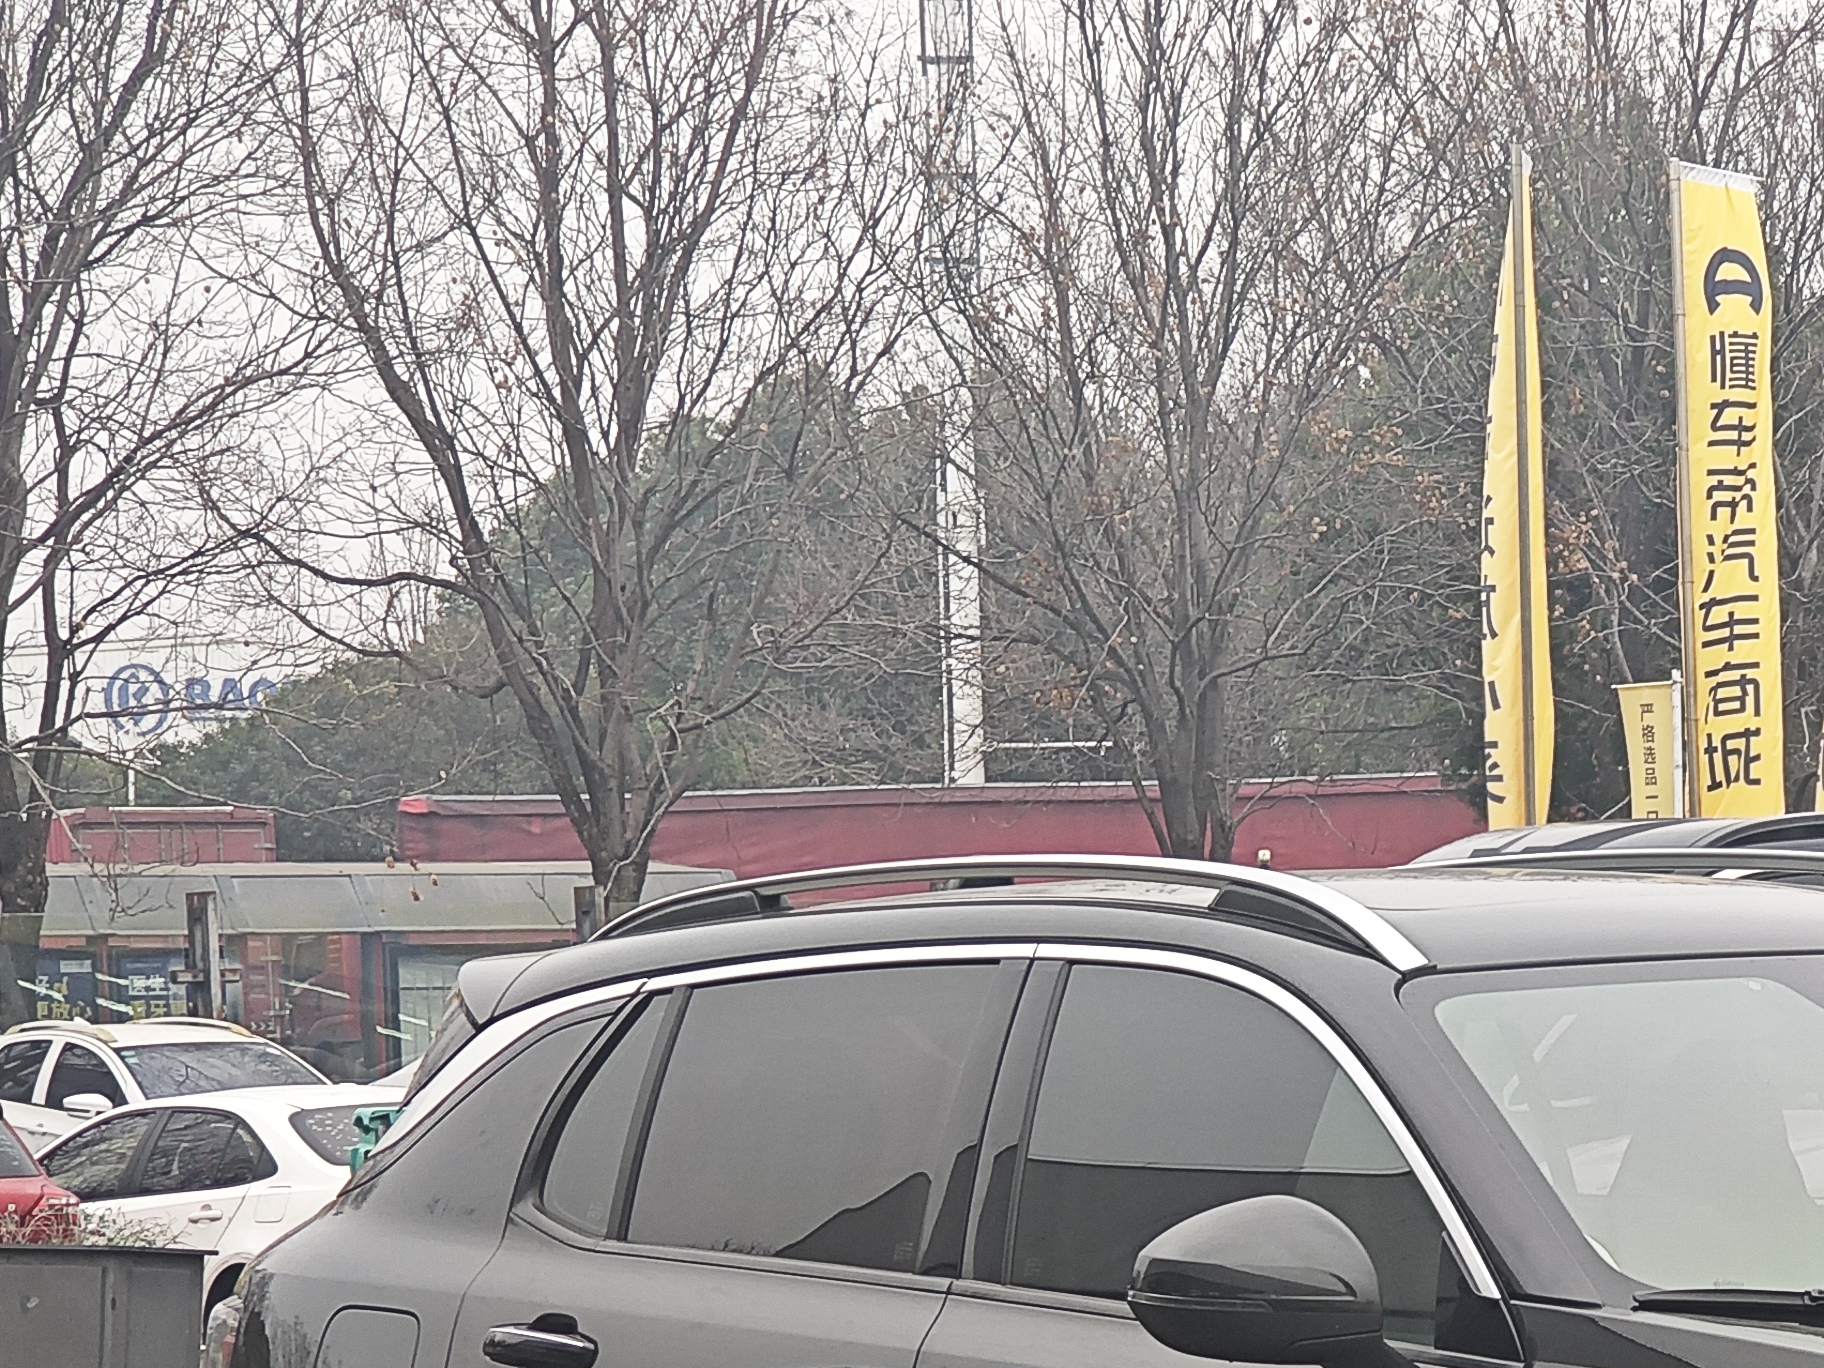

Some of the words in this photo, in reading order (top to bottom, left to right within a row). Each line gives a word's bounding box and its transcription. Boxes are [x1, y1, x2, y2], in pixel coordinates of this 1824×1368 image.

[1699, 329, 1762, 791] 懂车帝汽车商城
